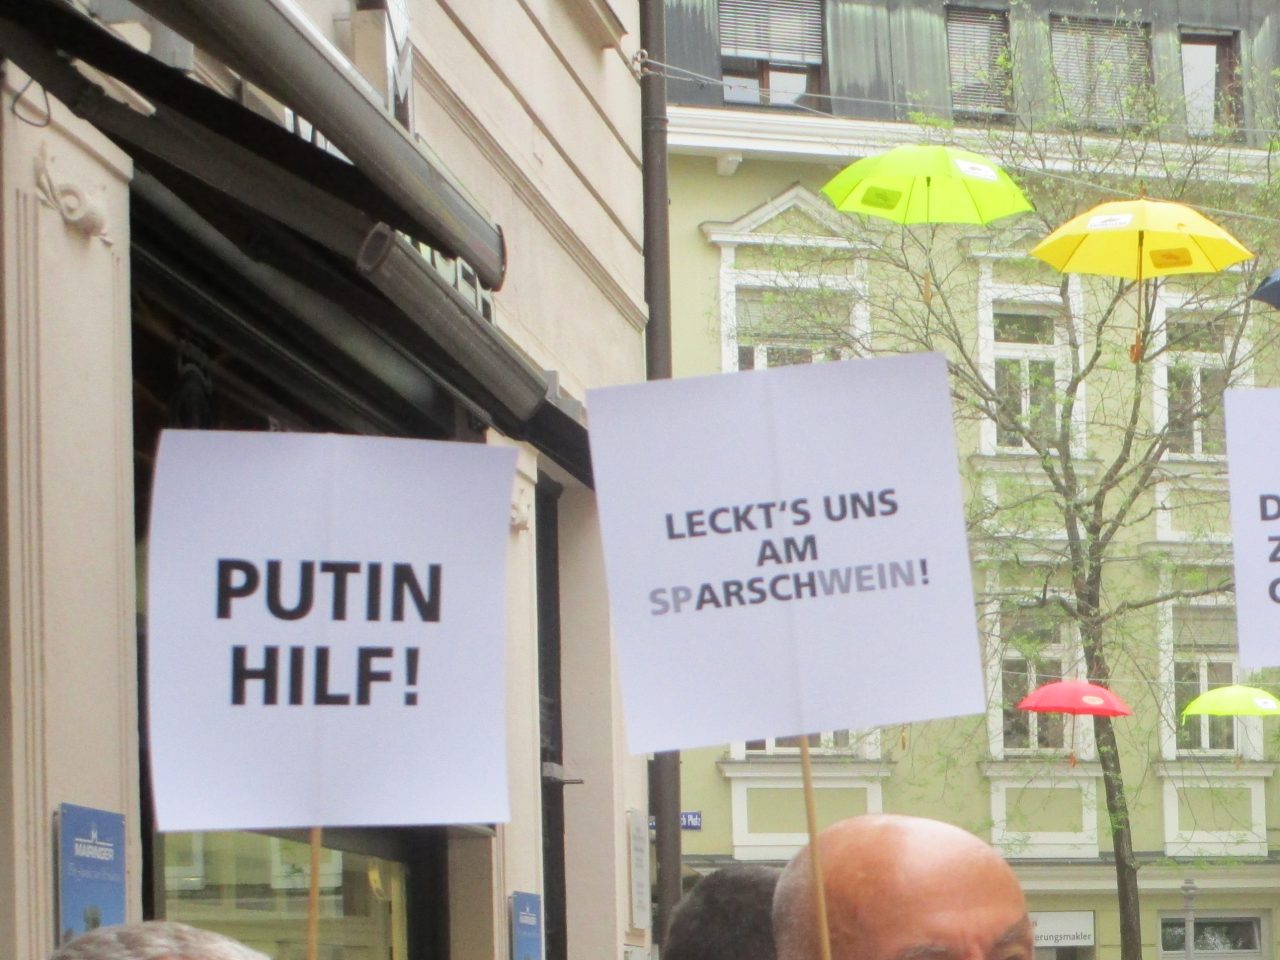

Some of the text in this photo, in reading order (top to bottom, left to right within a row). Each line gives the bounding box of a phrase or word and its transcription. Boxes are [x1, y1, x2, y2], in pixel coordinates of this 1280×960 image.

[823, 488, 899, 522] UNS
[756, 534, 818, 567] AM
[215, 557, 443, 623] PUTIN
[649, 558, 930, 616] SPARSCHWEIN!
[230, 644, 420, 707] HILF!
